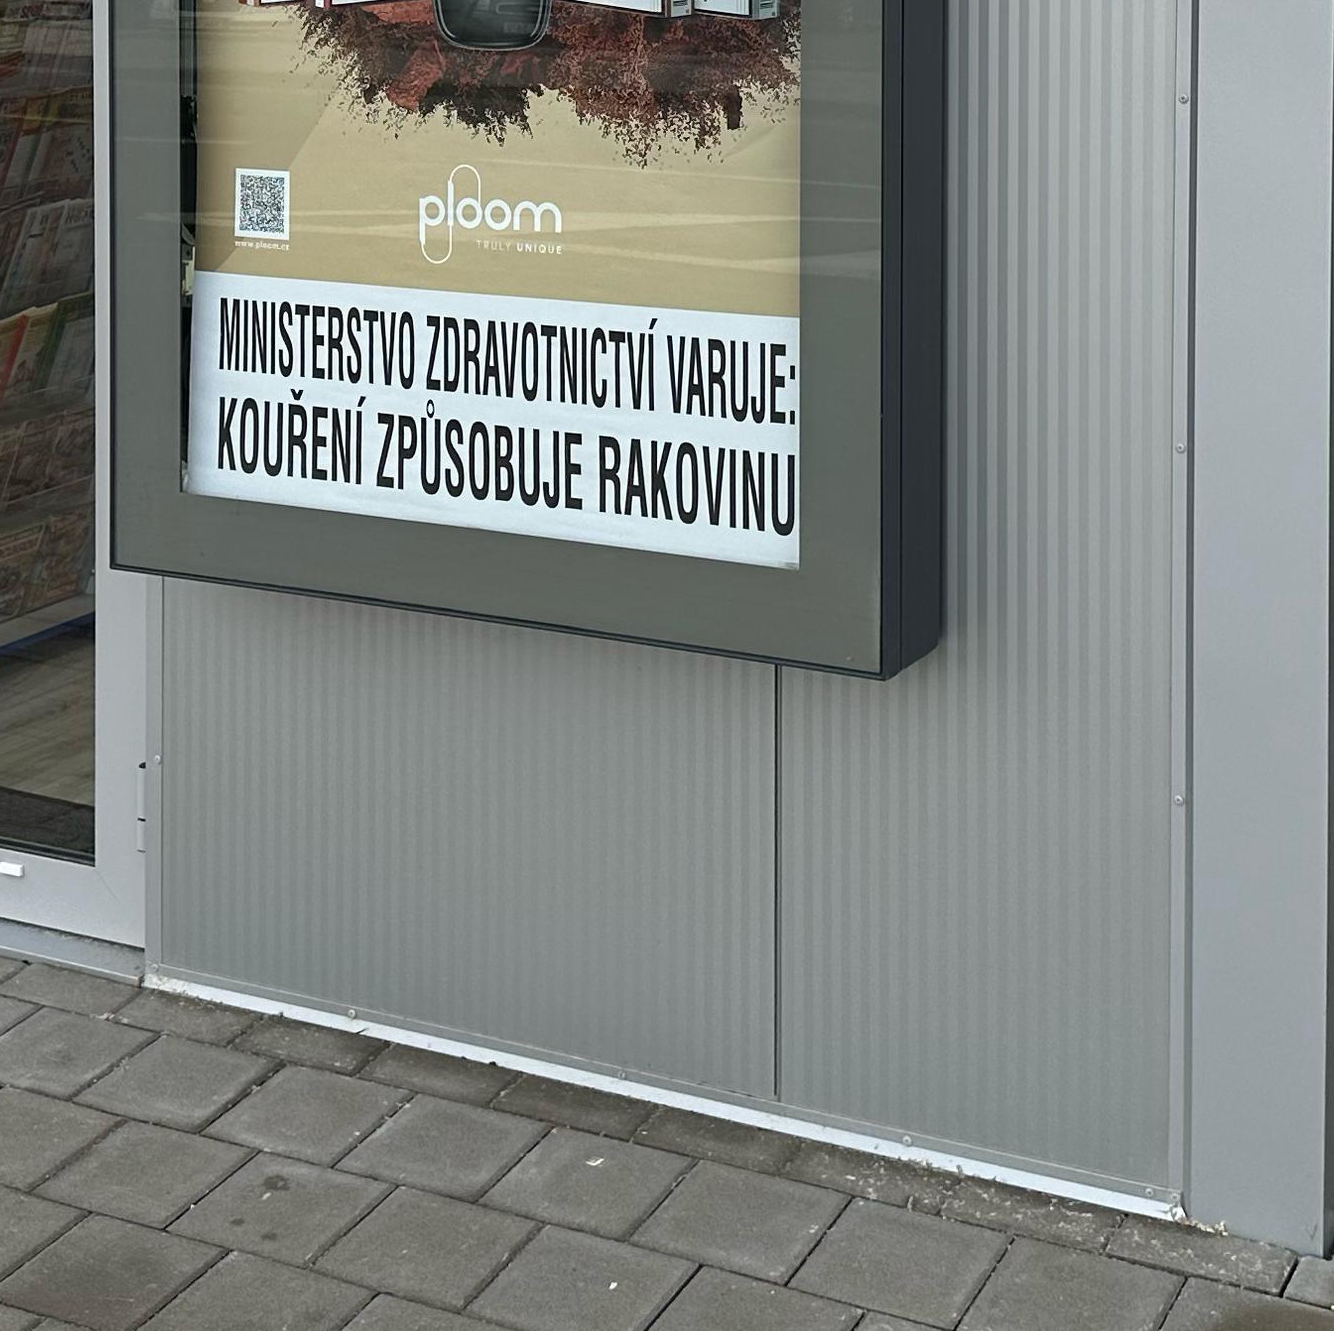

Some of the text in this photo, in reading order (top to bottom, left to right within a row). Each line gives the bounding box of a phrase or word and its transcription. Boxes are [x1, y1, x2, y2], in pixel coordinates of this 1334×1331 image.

[419, 164, 563, 264] ploom
[475, 239, 563, 256] TRULY UNIQUE
[219, 296, 797, 426] MINISTERSTVO ZDRAVOTNICTVÍ VARUJE:
[217, 388, 797, 537] KOUŘENÍ ZPŮSOBUJE RAKOVINU
